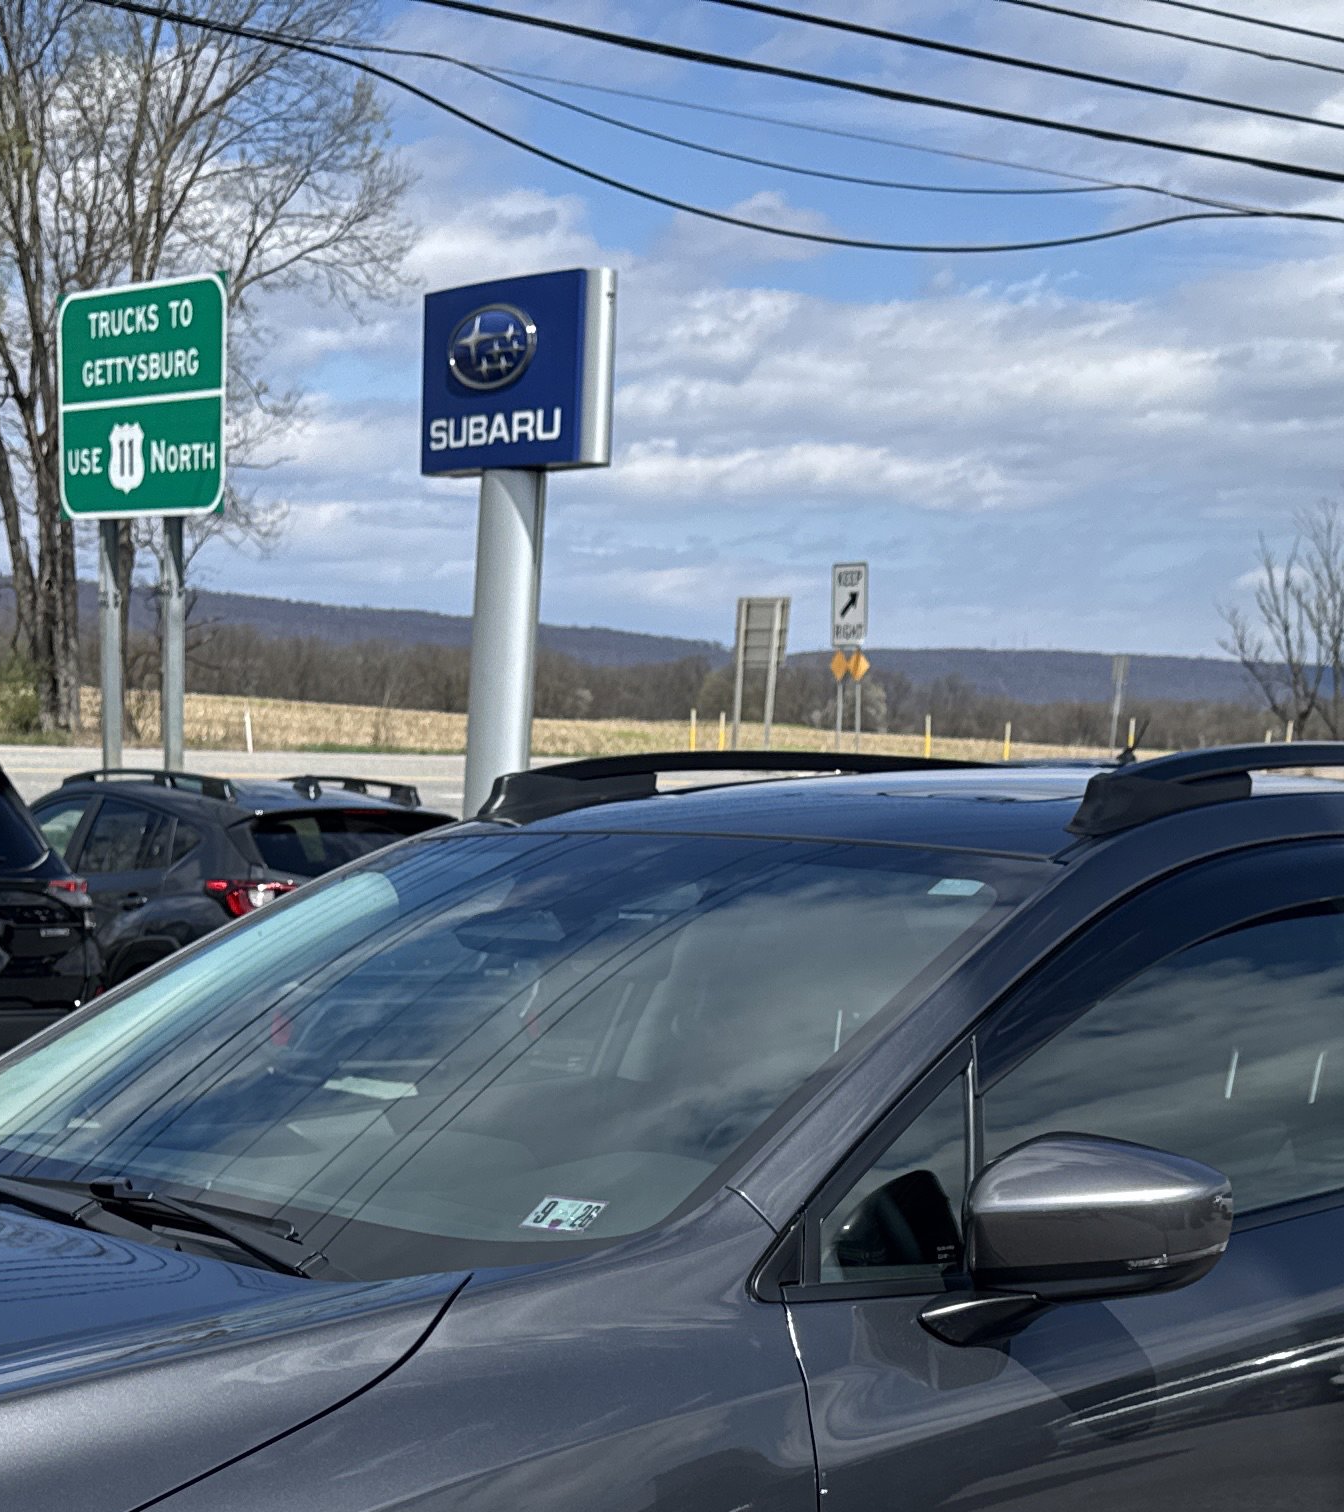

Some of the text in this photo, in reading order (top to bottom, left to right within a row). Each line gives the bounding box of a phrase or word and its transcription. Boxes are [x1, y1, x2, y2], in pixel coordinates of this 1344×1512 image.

[88, 298, 193, 339] TRUCKS TO
[82, 347, 200, 388] GETTYSBURG
[429, 406, 562, 452] SUBARU
[67, 438, 216, 477] USE 11 NORTH
[533, 1200, 559, 1224] 9
